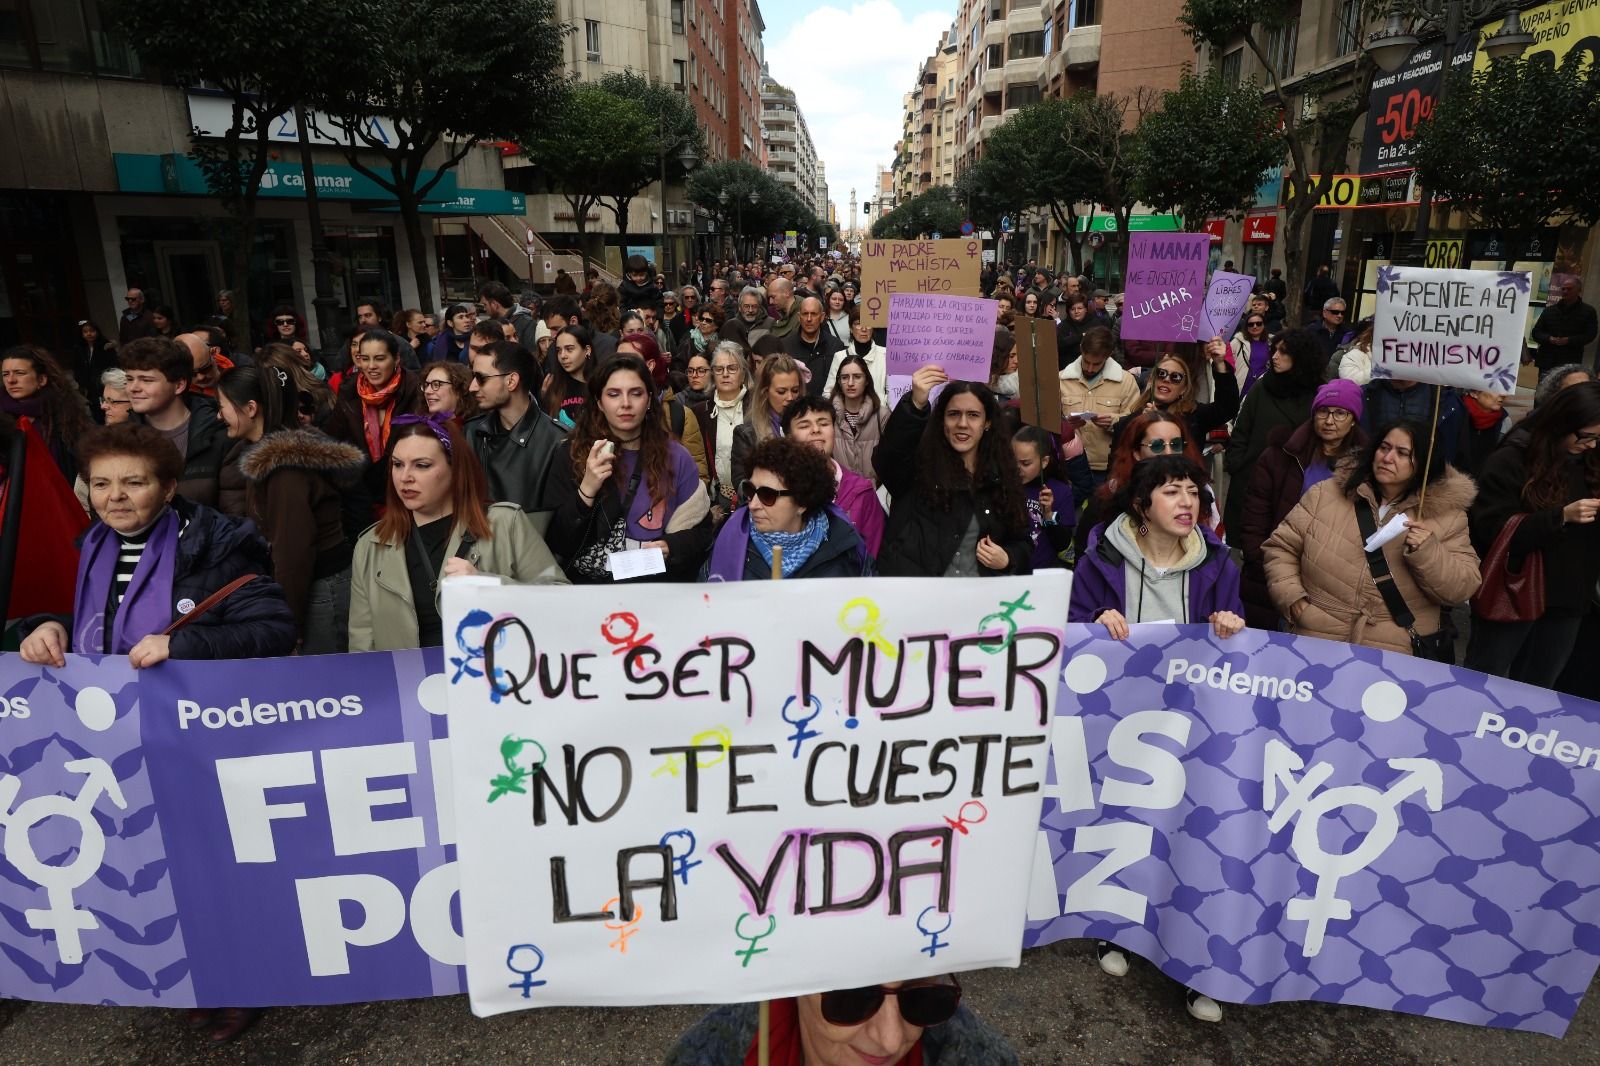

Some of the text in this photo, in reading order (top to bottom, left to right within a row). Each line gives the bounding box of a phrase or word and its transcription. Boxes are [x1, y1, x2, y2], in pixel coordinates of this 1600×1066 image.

[1521, 9, 1552, 33] MPRA
[1533, 22, 1570, 44] MPEÑO
[1409, 50, 1432, 64] JOYAS
[1372, 74, 1396, 90] NUEVAS
[1397, 72, 1402, 83] Y
[1378, 146, 1389, 160] En
[1389, 145, 1397, 158] la
[283, 171, 352, 191] cajmar
[1386, 177, 1407, 188] Compra
[1387, 190, 1402, 200] Venta
[866, 241, 936, 259] UN PADRE
[890, 256, 961, 273] MACHISTA
[876, 276, 952, 295] ME HIZO
[1129, 270, 1144, 285] ME
[1188, 271, 1197, 286] A
[1130, 287, 1193, 319] LUCHAR
[1389, 280, 1475, 309] FRENTE
[1480, 287, 1491, 307] A
[1496, 286, 1517, 314] LA
[1393, 311, 1494, 339] VIOLENCIA
[921, 352, 933, 362] EN
[935, 352, 945, 361] EL
[946, 352, 985, 364] EMBARAZO
[1381, 338, 1501, 370] FEMINISMO
[483, 616, 1062, 727] QUE SER MUJER
[1165, 657, 1314, 703] Podemos
[178, 694, 363, 730] Podemos
[531, 734, 1047, 827] NO TE CUESTE
[215, 739, 458, 864] FE
[549, 826, 954, 924] LA VIDA
